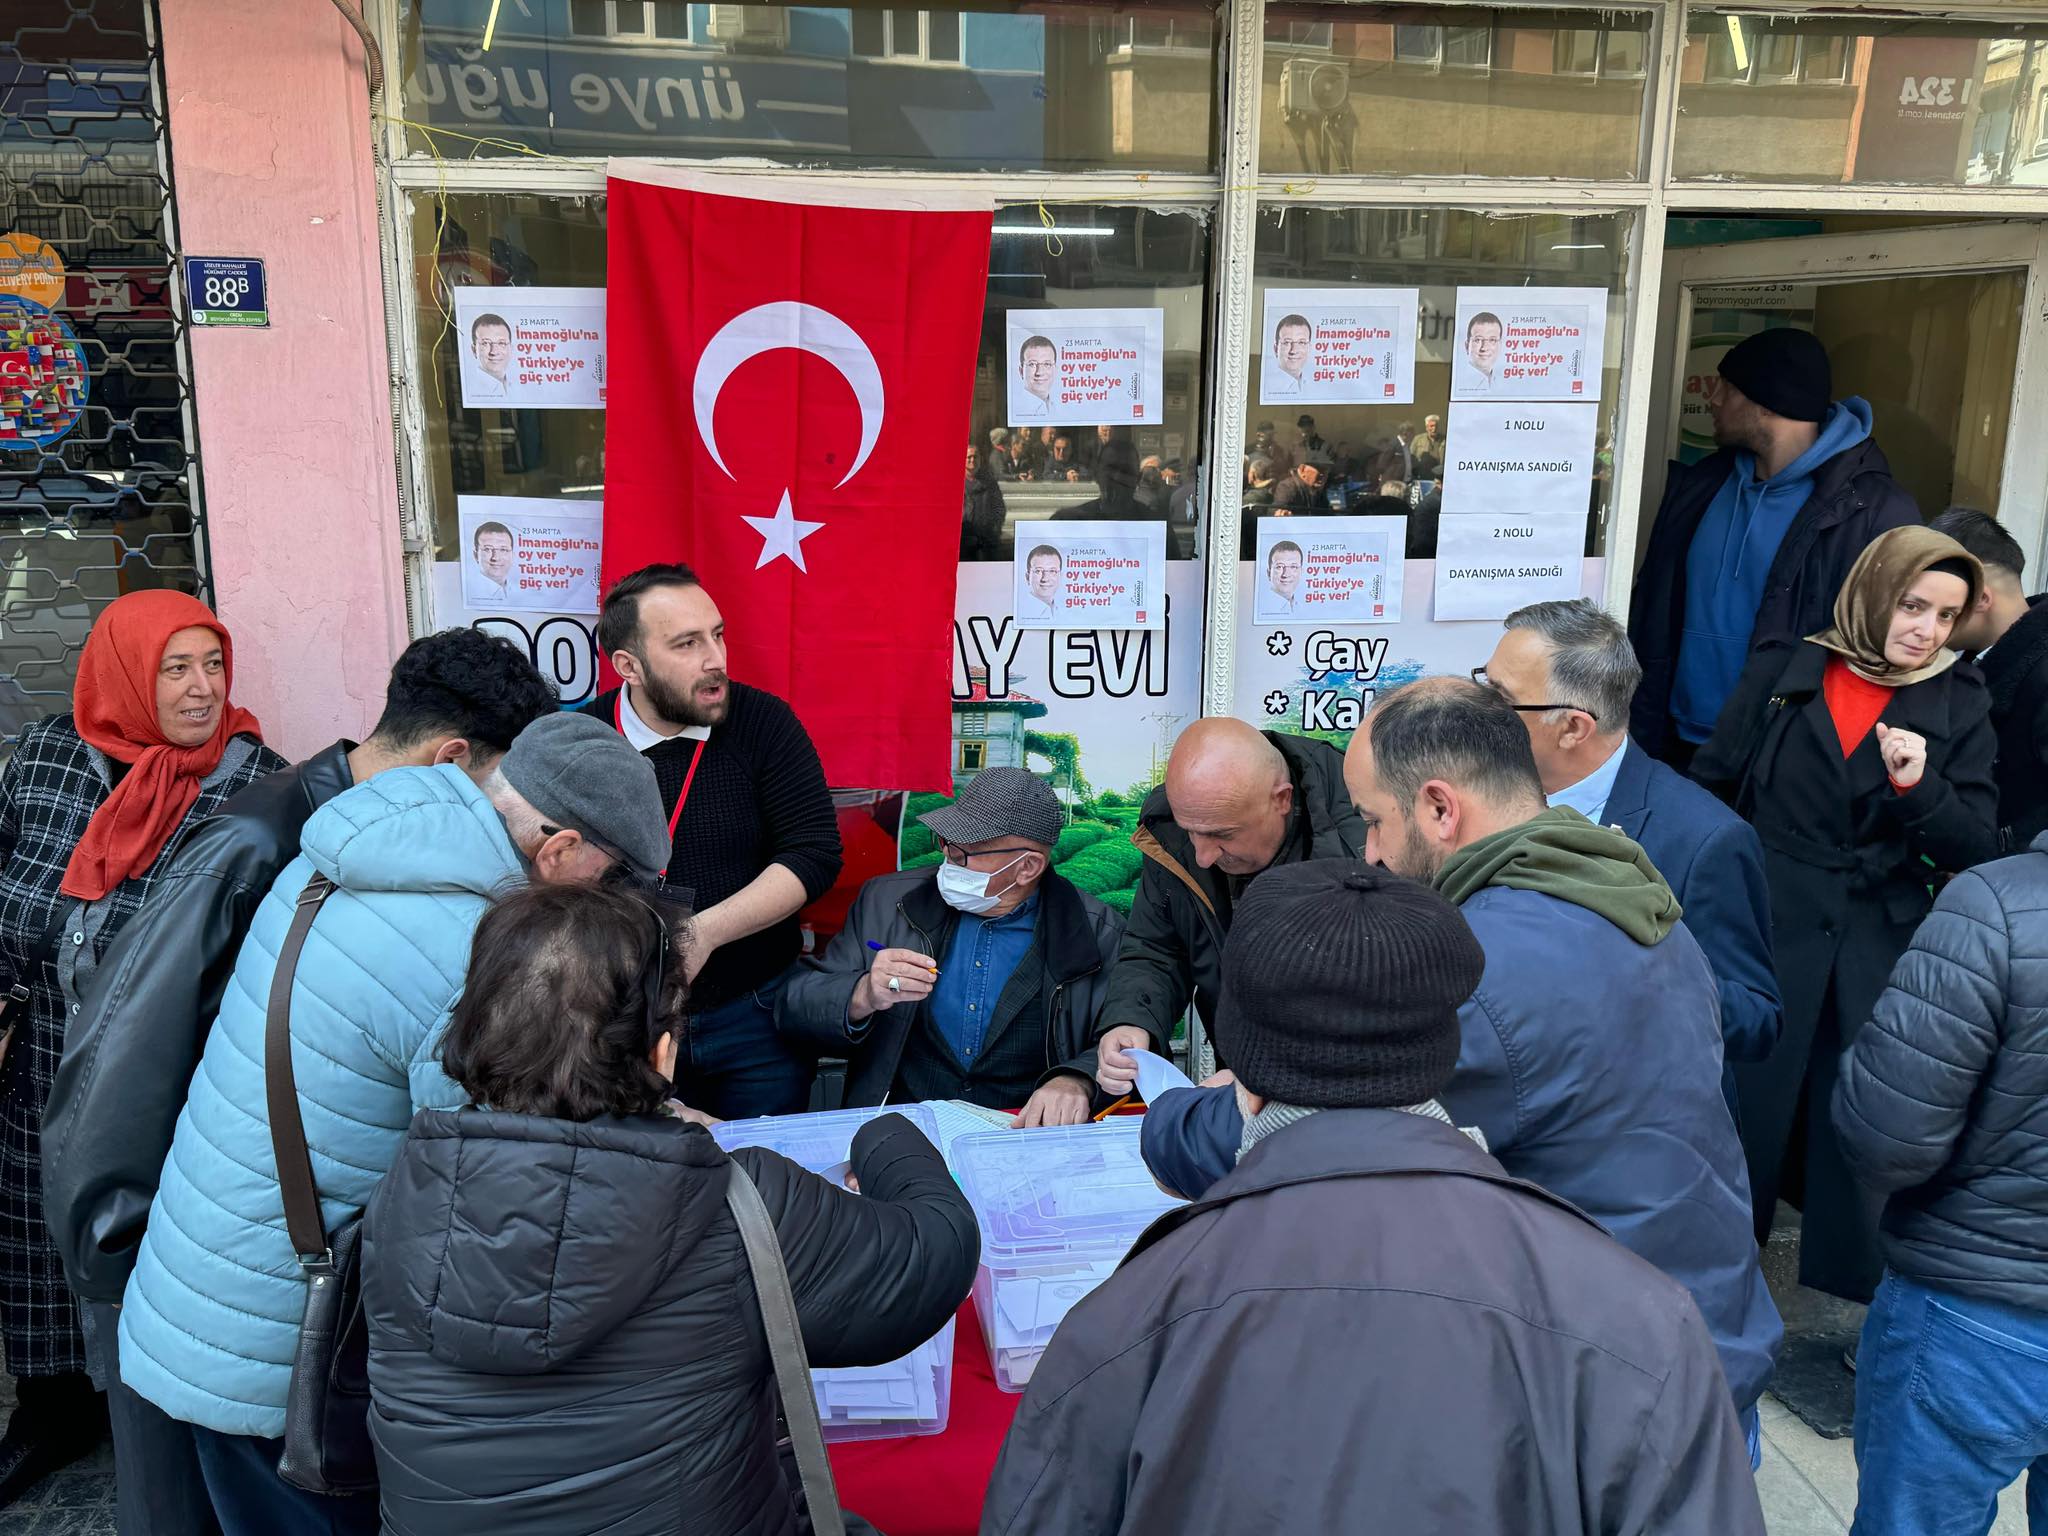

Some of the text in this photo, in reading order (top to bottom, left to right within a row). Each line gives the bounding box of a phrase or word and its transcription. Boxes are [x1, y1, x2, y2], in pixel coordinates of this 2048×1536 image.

[34, 272, 58, 286] POINT
[520, 318, 528, 326] 23
[515, 326, 599, 342] İmamoğlu'na
[1315, 326, 1391, 341] İmamoğlu'na
[1506, 323, 1579, 338] İmamoğlu'na
[517, 342, 556, 354] oy ver
[1315, 342, 1350, 353] oy ver
[1505, 339, 1540, 350] oy ver
[1061, 347, 1137, 361] İmamoğlu'na
[1505, 352, 1563, 365] Türkiye'ye
[517, 356, 585, 371] Türkiye'ye
[1314, 354, 1374, 368] Türkiye'ye
[1061, 363, 1097, 374] oy ver
[1503, 366, 1549, 379] güç ver!
[519, 372, 570, 385] güç ver!
[1313, 369, 1360, 382] güç ver!
[1061, 376, 1122, 389] Türkiye'ye
[1061, 390, 1108, 403] güç ver!
[1504, 420, 1545, 431] 1 NOLU
[1458, 460, 1573, 474] DAYANIŞMA SANDIĞI
[522, 527, 531, 535] 23
[1493, 528, 1533, 538] 2 NOLU
[518, 534, 599, 551] İmamoğlu'na
[518, 550, 557, 561] oy ver
[1307, 551, 1379, 564] İmamoğlu'na
[1066, 555, 1140, 570] İmamoğlu'na
[518, 563, 584, 578] Türkiye'ye
[1066, 570, 1101, 581] oy ver
[1306, 566, 1340, 576] oy ver
[1449, 565, 1563, 580] DAYANIŞMA SANDIĞI
[520, 577, 569, 590] güç ver!
[1065, 583, 1125, 595] Türkiye'ye
[1306, 578, 1364, 590] Türkiye'ye
[1065, 596, 1111, 608] güç ver!
[1305, 591, 1350, 603] güç ver!
[1305, 630, 1389, 681] Çay
